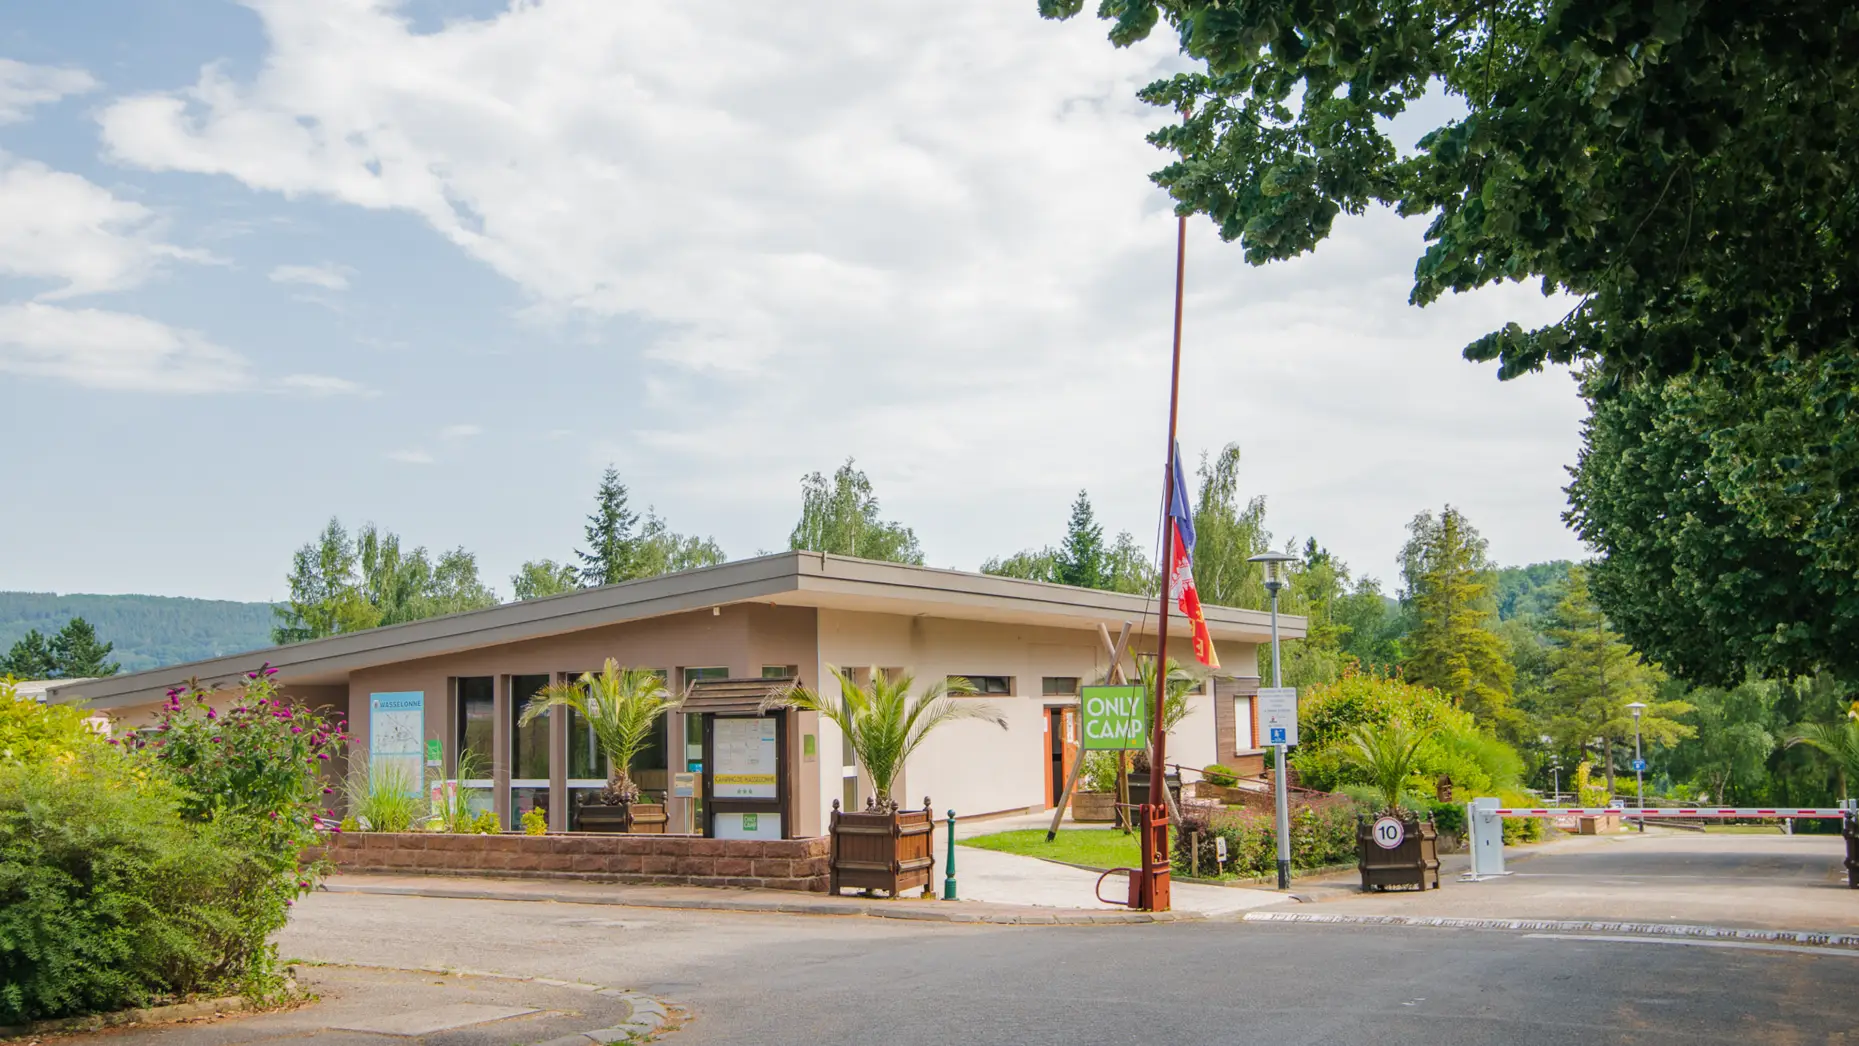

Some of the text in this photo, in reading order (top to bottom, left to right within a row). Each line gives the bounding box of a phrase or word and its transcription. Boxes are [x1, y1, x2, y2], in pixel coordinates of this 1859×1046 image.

[380, 700, 421, 708] WASSELONNE
[1087, 697, 1140, 716] ONLY
[1086, 719, 1142, 738] CAMP
[1378, 825, 1397, 840] 10
